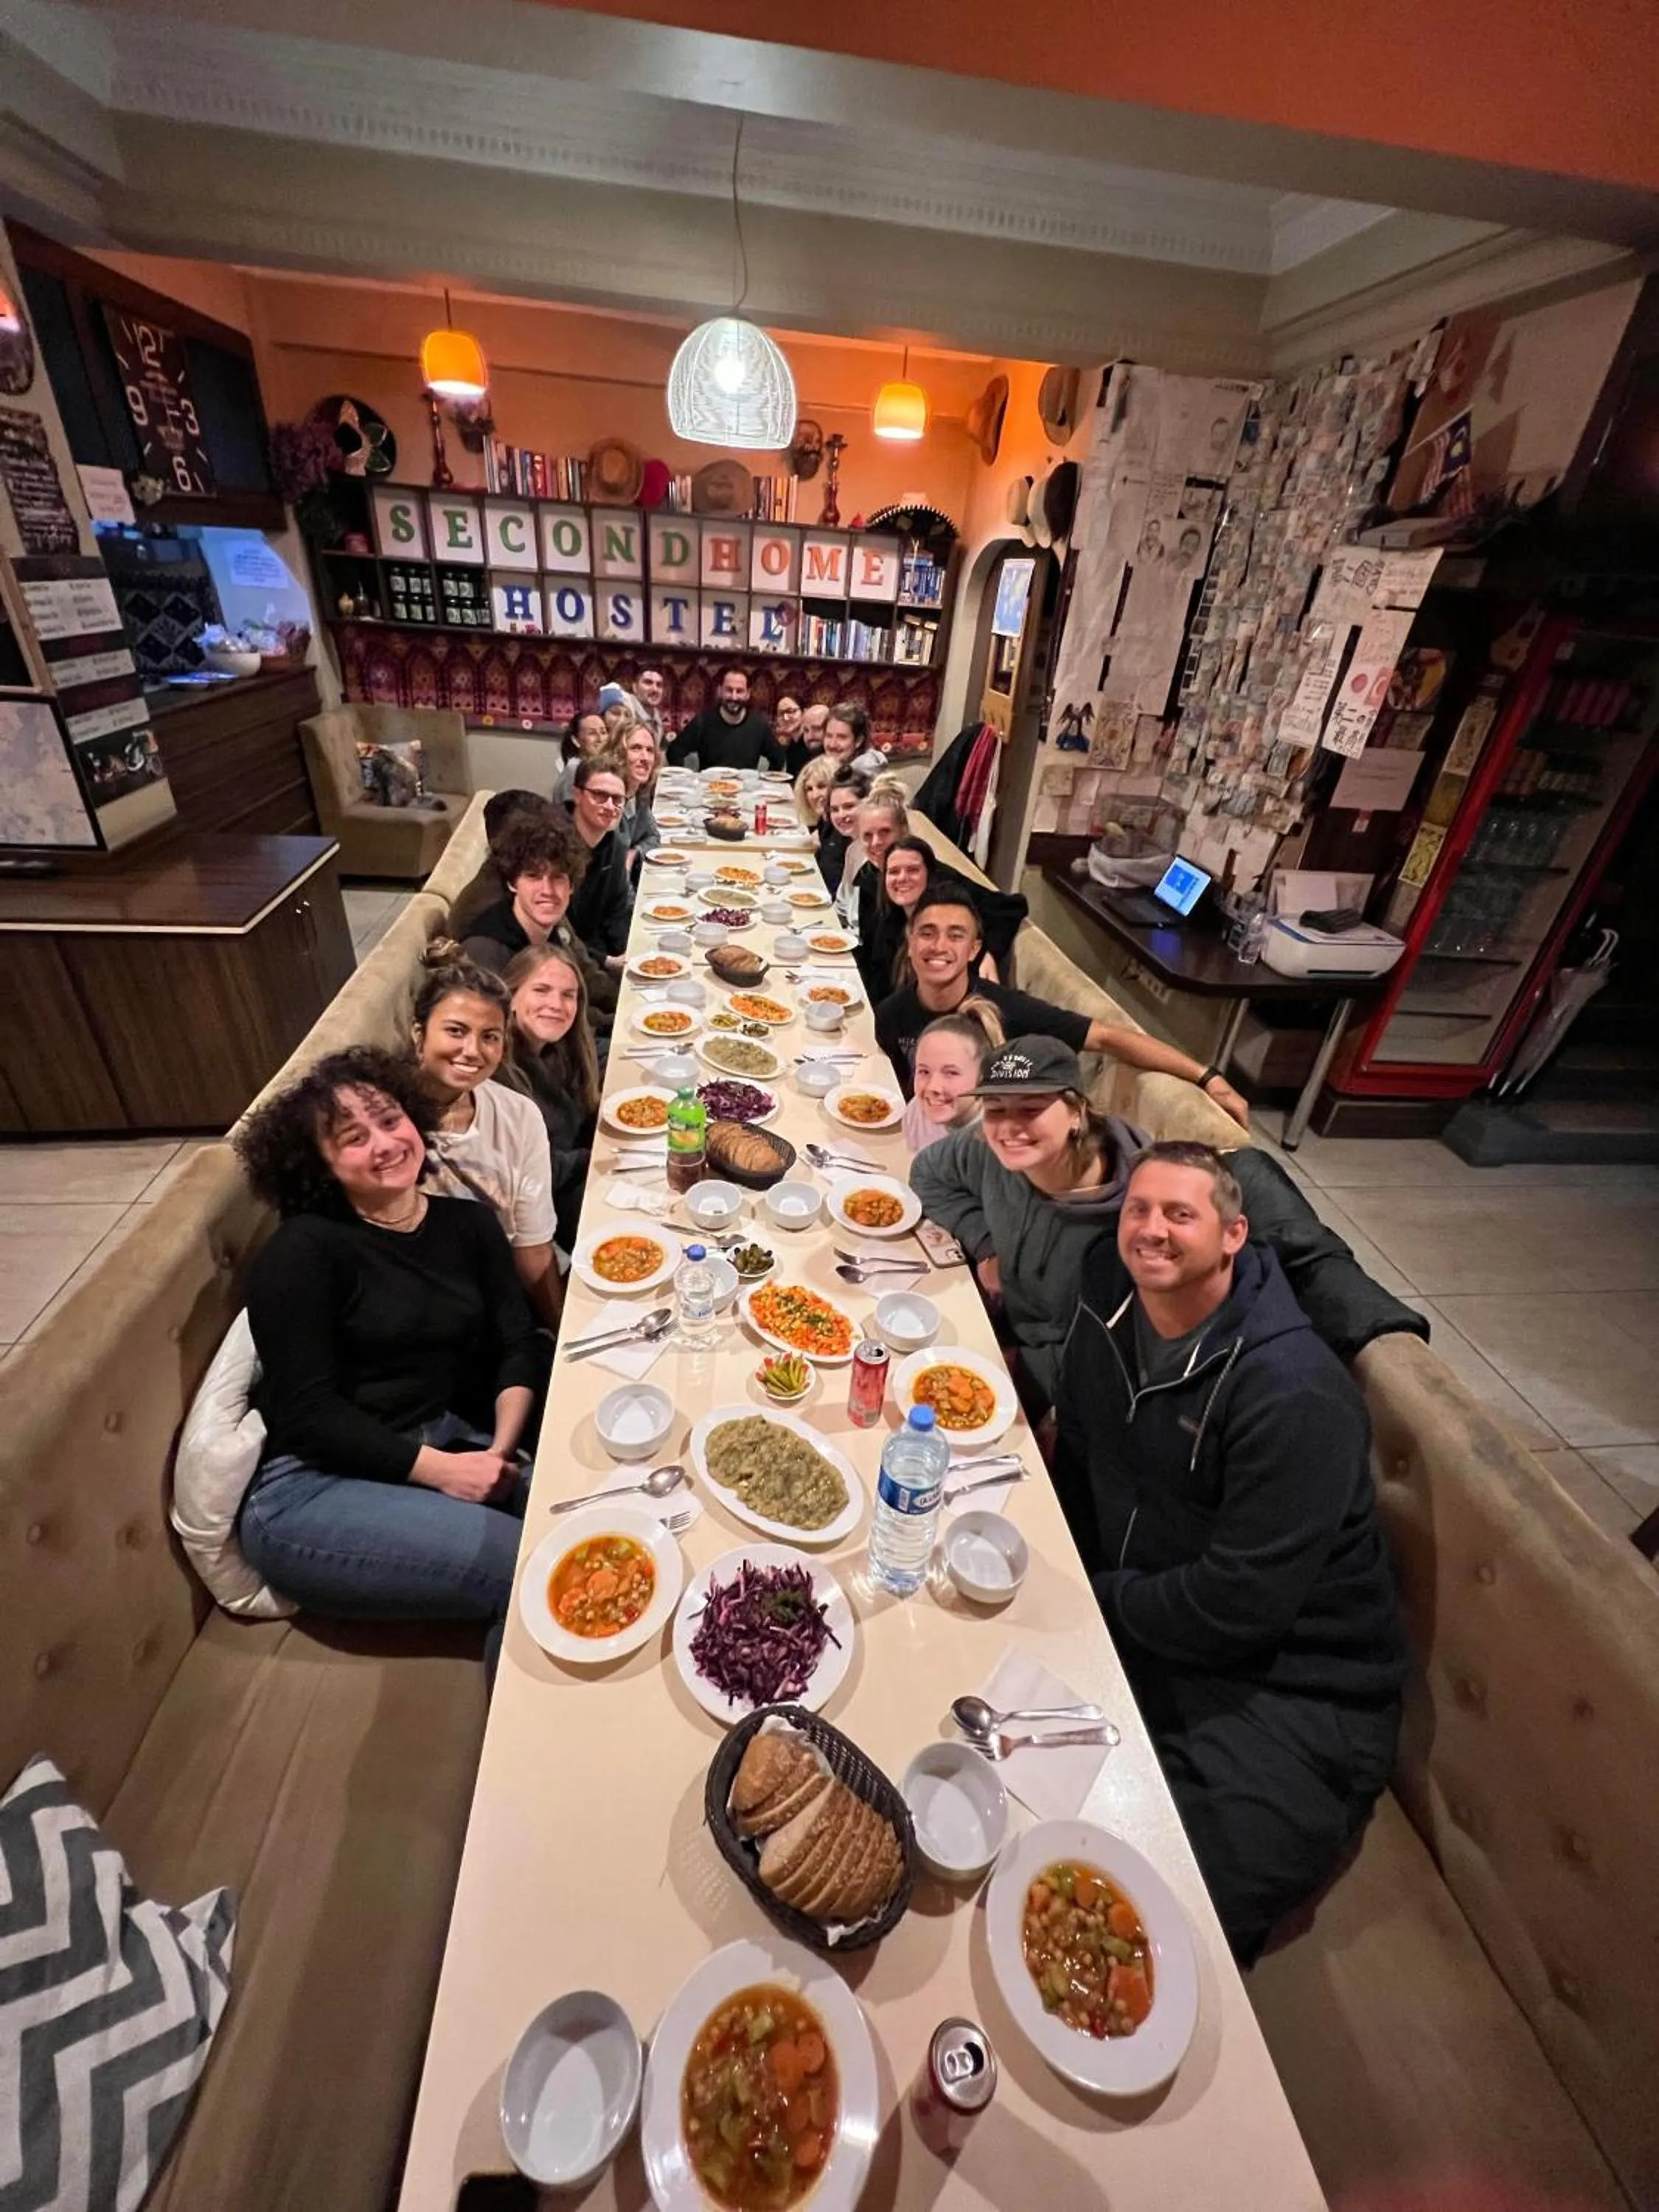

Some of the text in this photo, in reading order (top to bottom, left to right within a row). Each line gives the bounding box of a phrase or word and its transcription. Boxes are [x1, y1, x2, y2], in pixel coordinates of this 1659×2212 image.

[132, 321, 161, 367] 12
[125, 385, 148, 426] 9
[180, 398, 201, 437] 3
[172, 456, 192, 492] 6
[389, 504, 885, 585] SECOND HOME
[501, 585, 784, 642] HOSTEL
